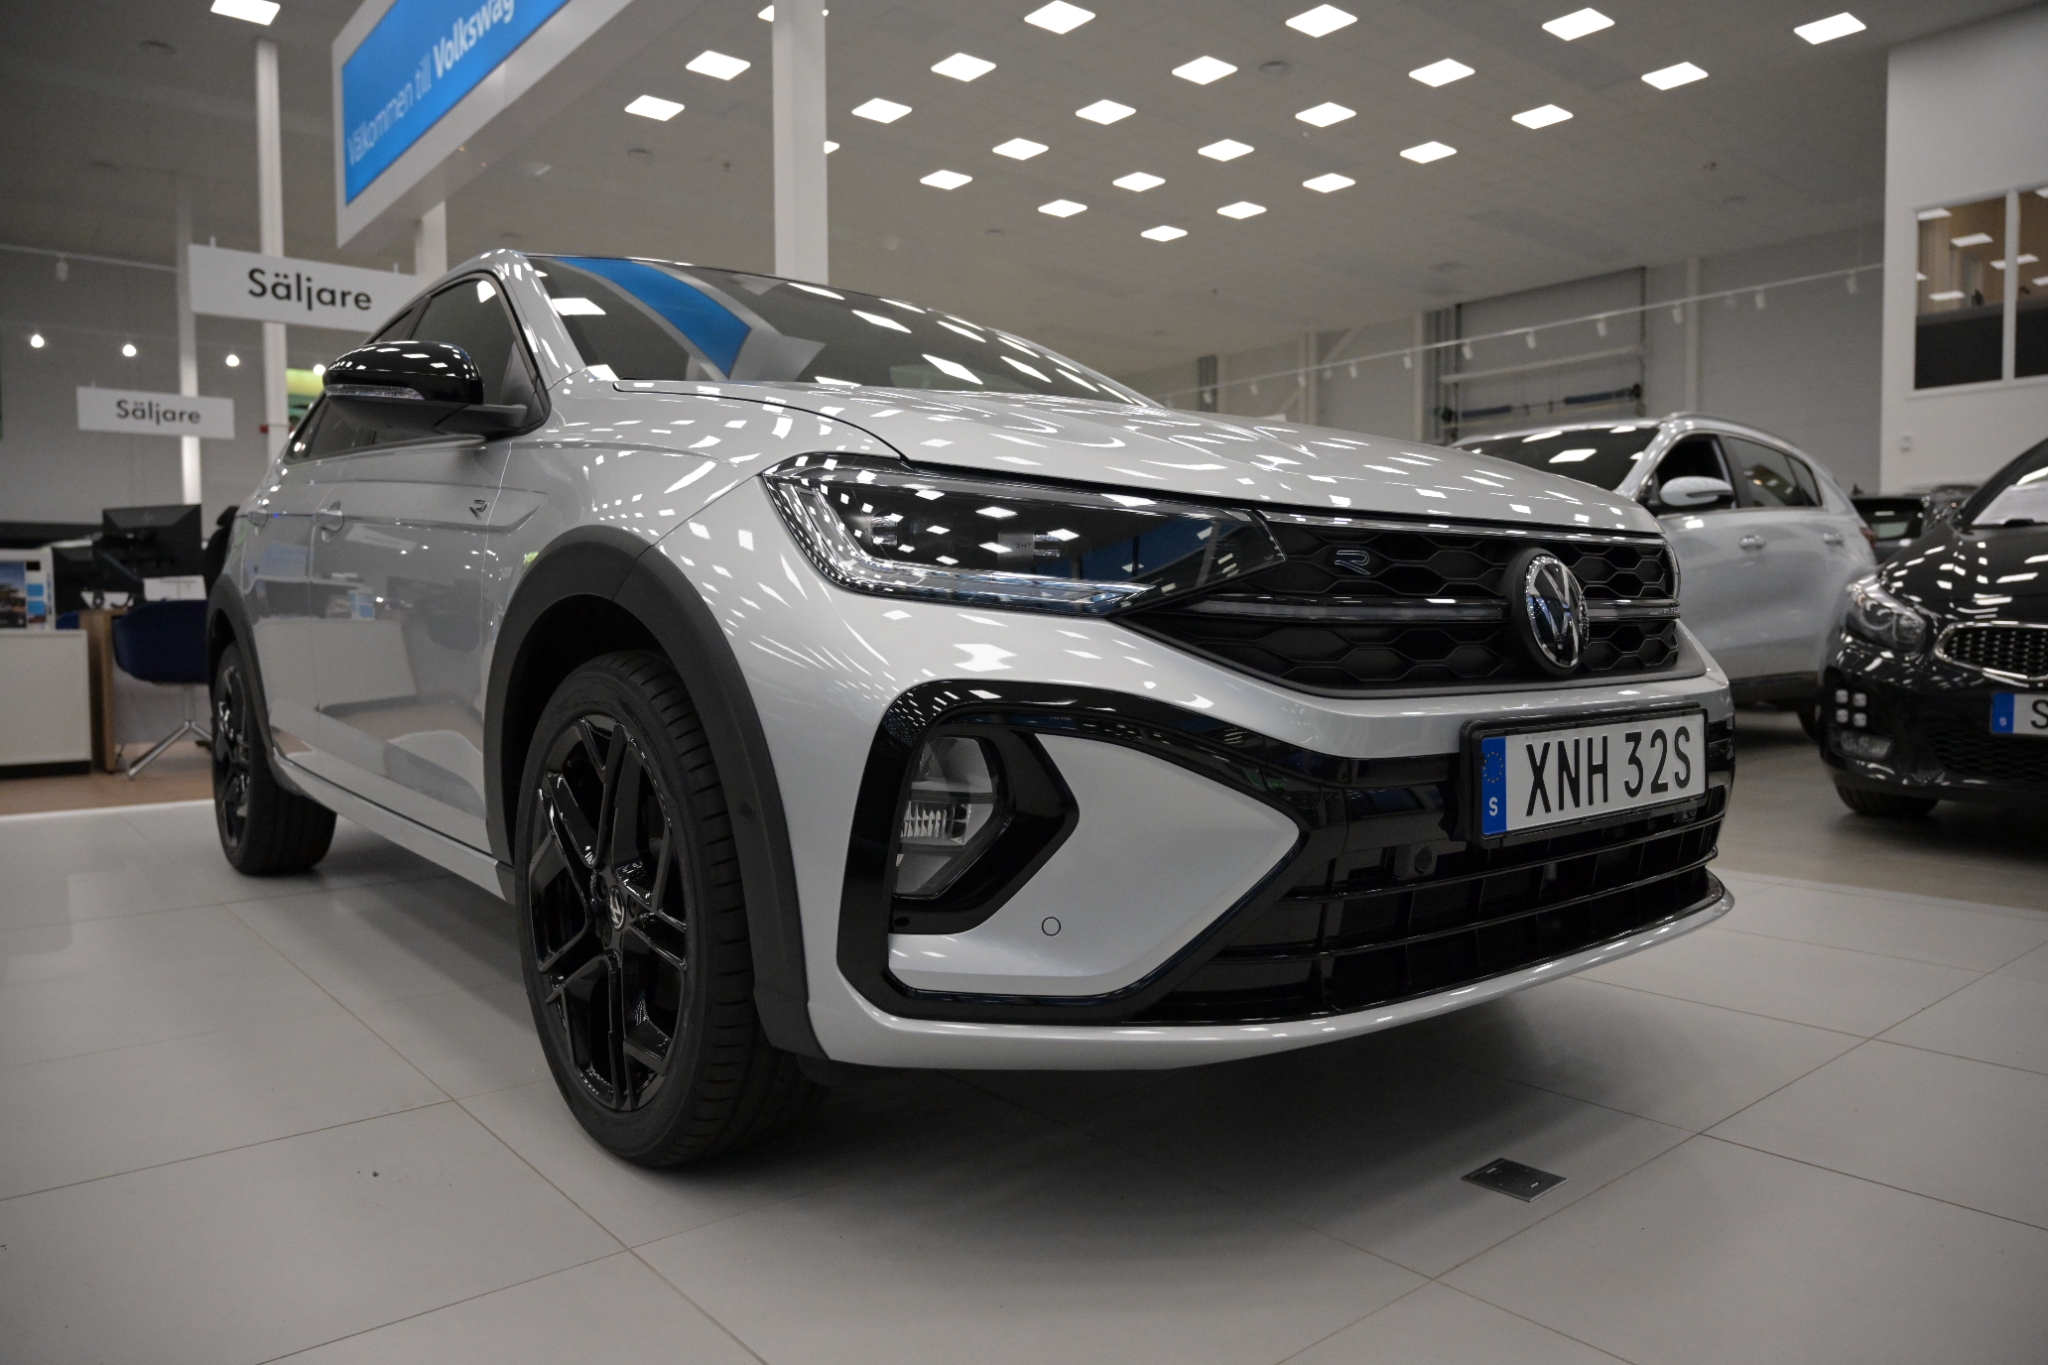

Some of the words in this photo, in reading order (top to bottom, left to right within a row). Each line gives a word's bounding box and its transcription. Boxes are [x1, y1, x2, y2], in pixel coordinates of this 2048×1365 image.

[415, 53, 432, 100] till
[248, 268, 372, 311] Säljare
[116, 399, 201, 426] Säljare
[1526, 735, 1608, 816] XNH
[1624, 726, 1691, 797] 32S
[1488, 796, 1498, 816] S
